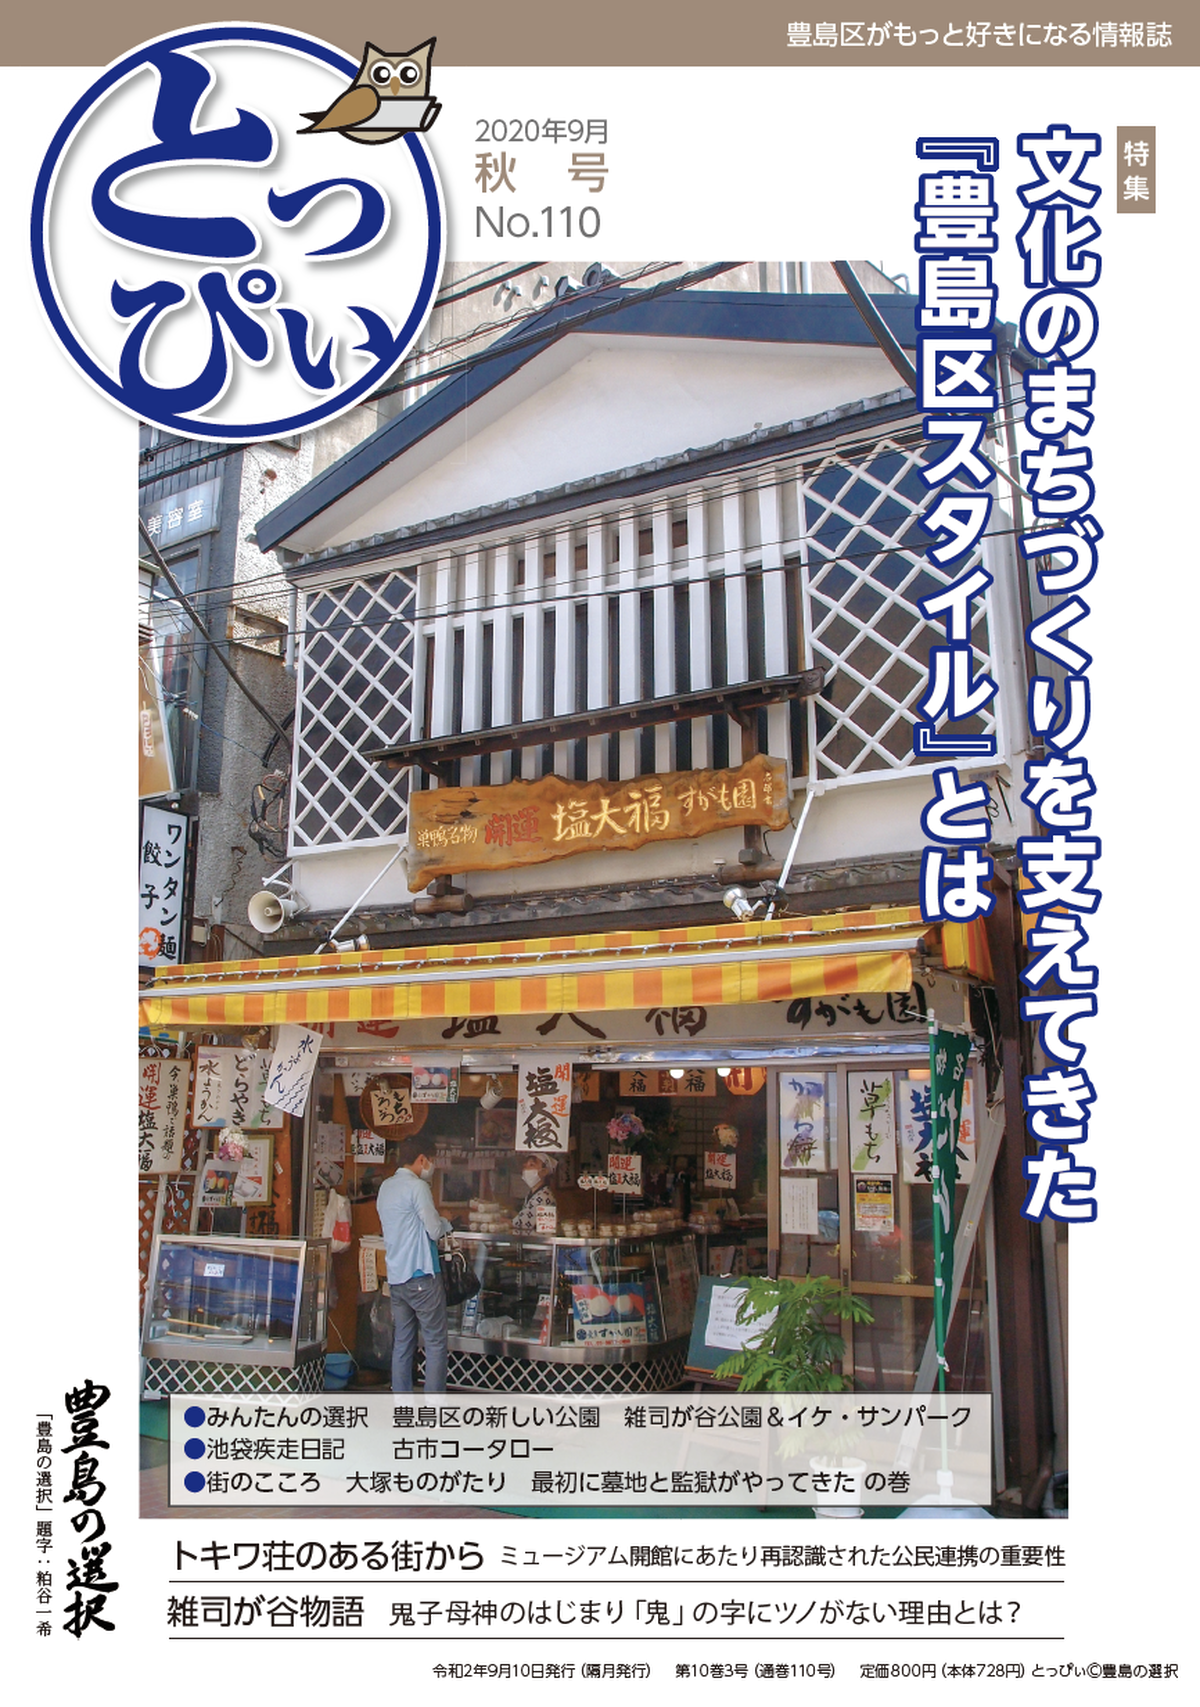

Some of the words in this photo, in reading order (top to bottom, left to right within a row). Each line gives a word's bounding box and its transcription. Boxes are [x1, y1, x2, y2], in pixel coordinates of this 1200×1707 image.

[147, 499, 205, 537] 美容室
[416, 823, 479, 848] 巣鴨名物
[484, 805, 544, 848] 開運
[551, 784, 671, 843] 塩大福
[676, 777, 758, 818] すがも園
[140, 841, 164, 910] 餃子
[156, 822, 184, 961] ワンタン麺
[229, 1053, 257, 1126] どらやき
[522, 1066, 563, 1150] 塩大福
[549, 1062, 571, 1117] 開運
[859, 1077, 886, 1164] 草もち
